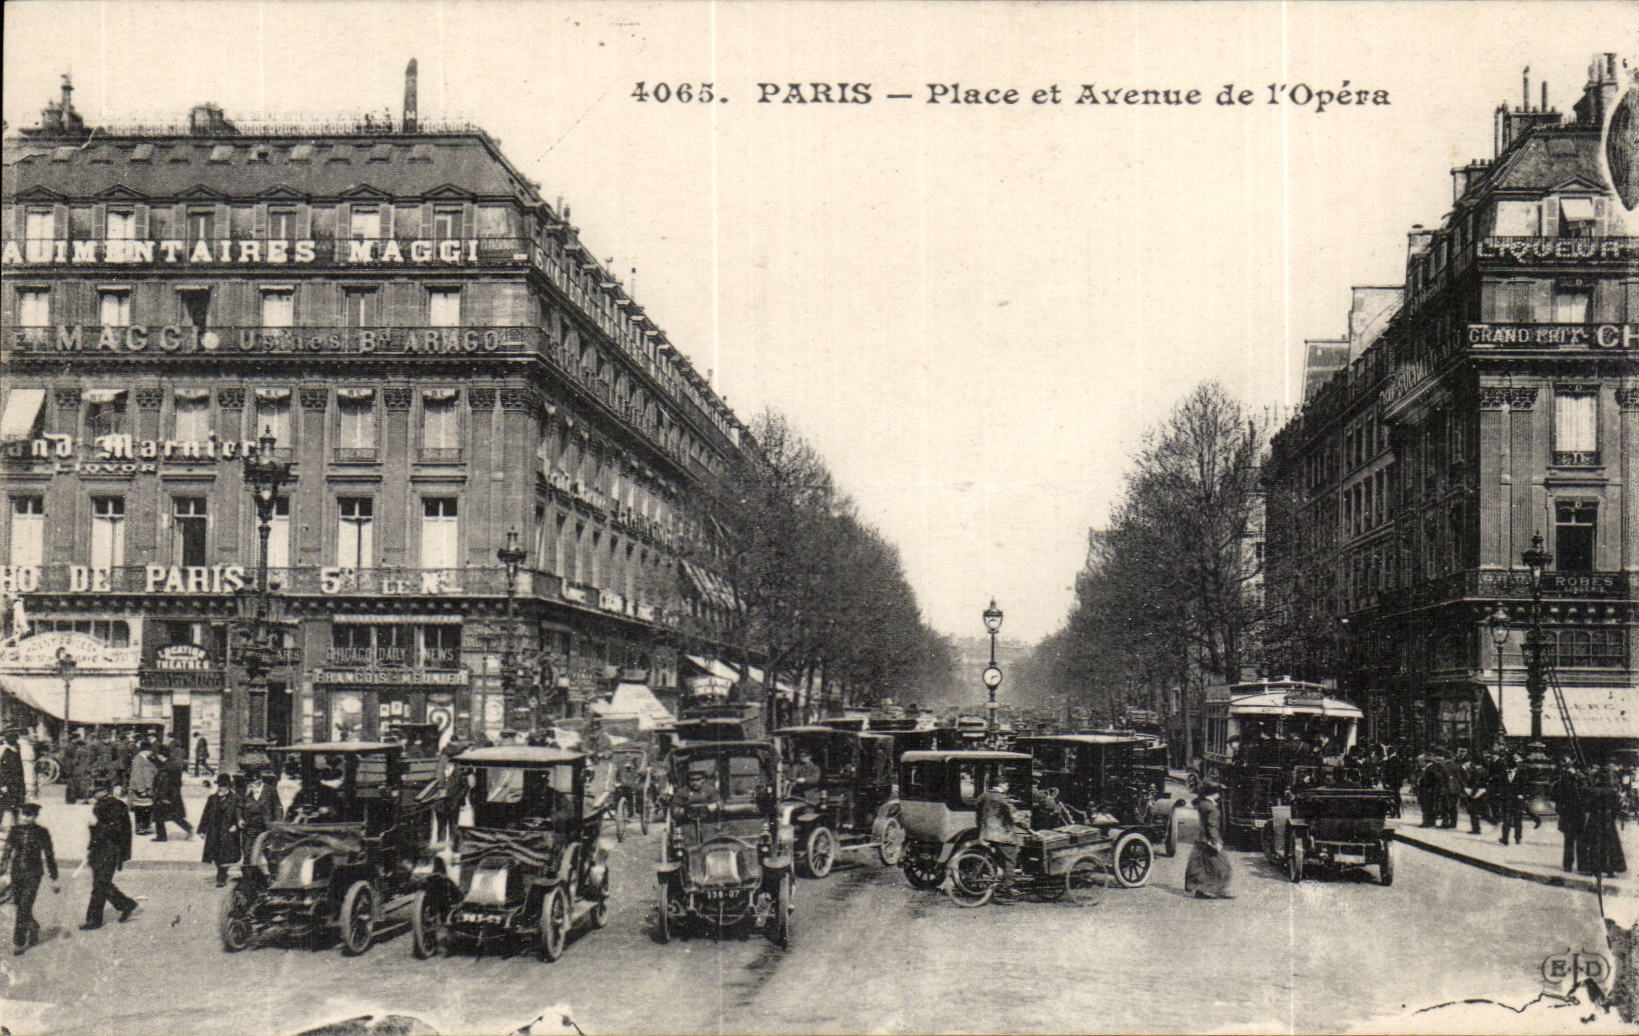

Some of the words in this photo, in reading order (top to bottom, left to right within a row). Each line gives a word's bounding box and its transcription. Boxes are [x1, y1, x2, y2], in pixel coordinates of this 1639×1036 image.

[349, 239, 479, 263] MAGGI
[1469, 328, 1530, 343] GRAND
[69, 565, 111, 593] DE
[145, 565, 244, 593] PARIS
[1555, 576, 1614, 586] ROBES
